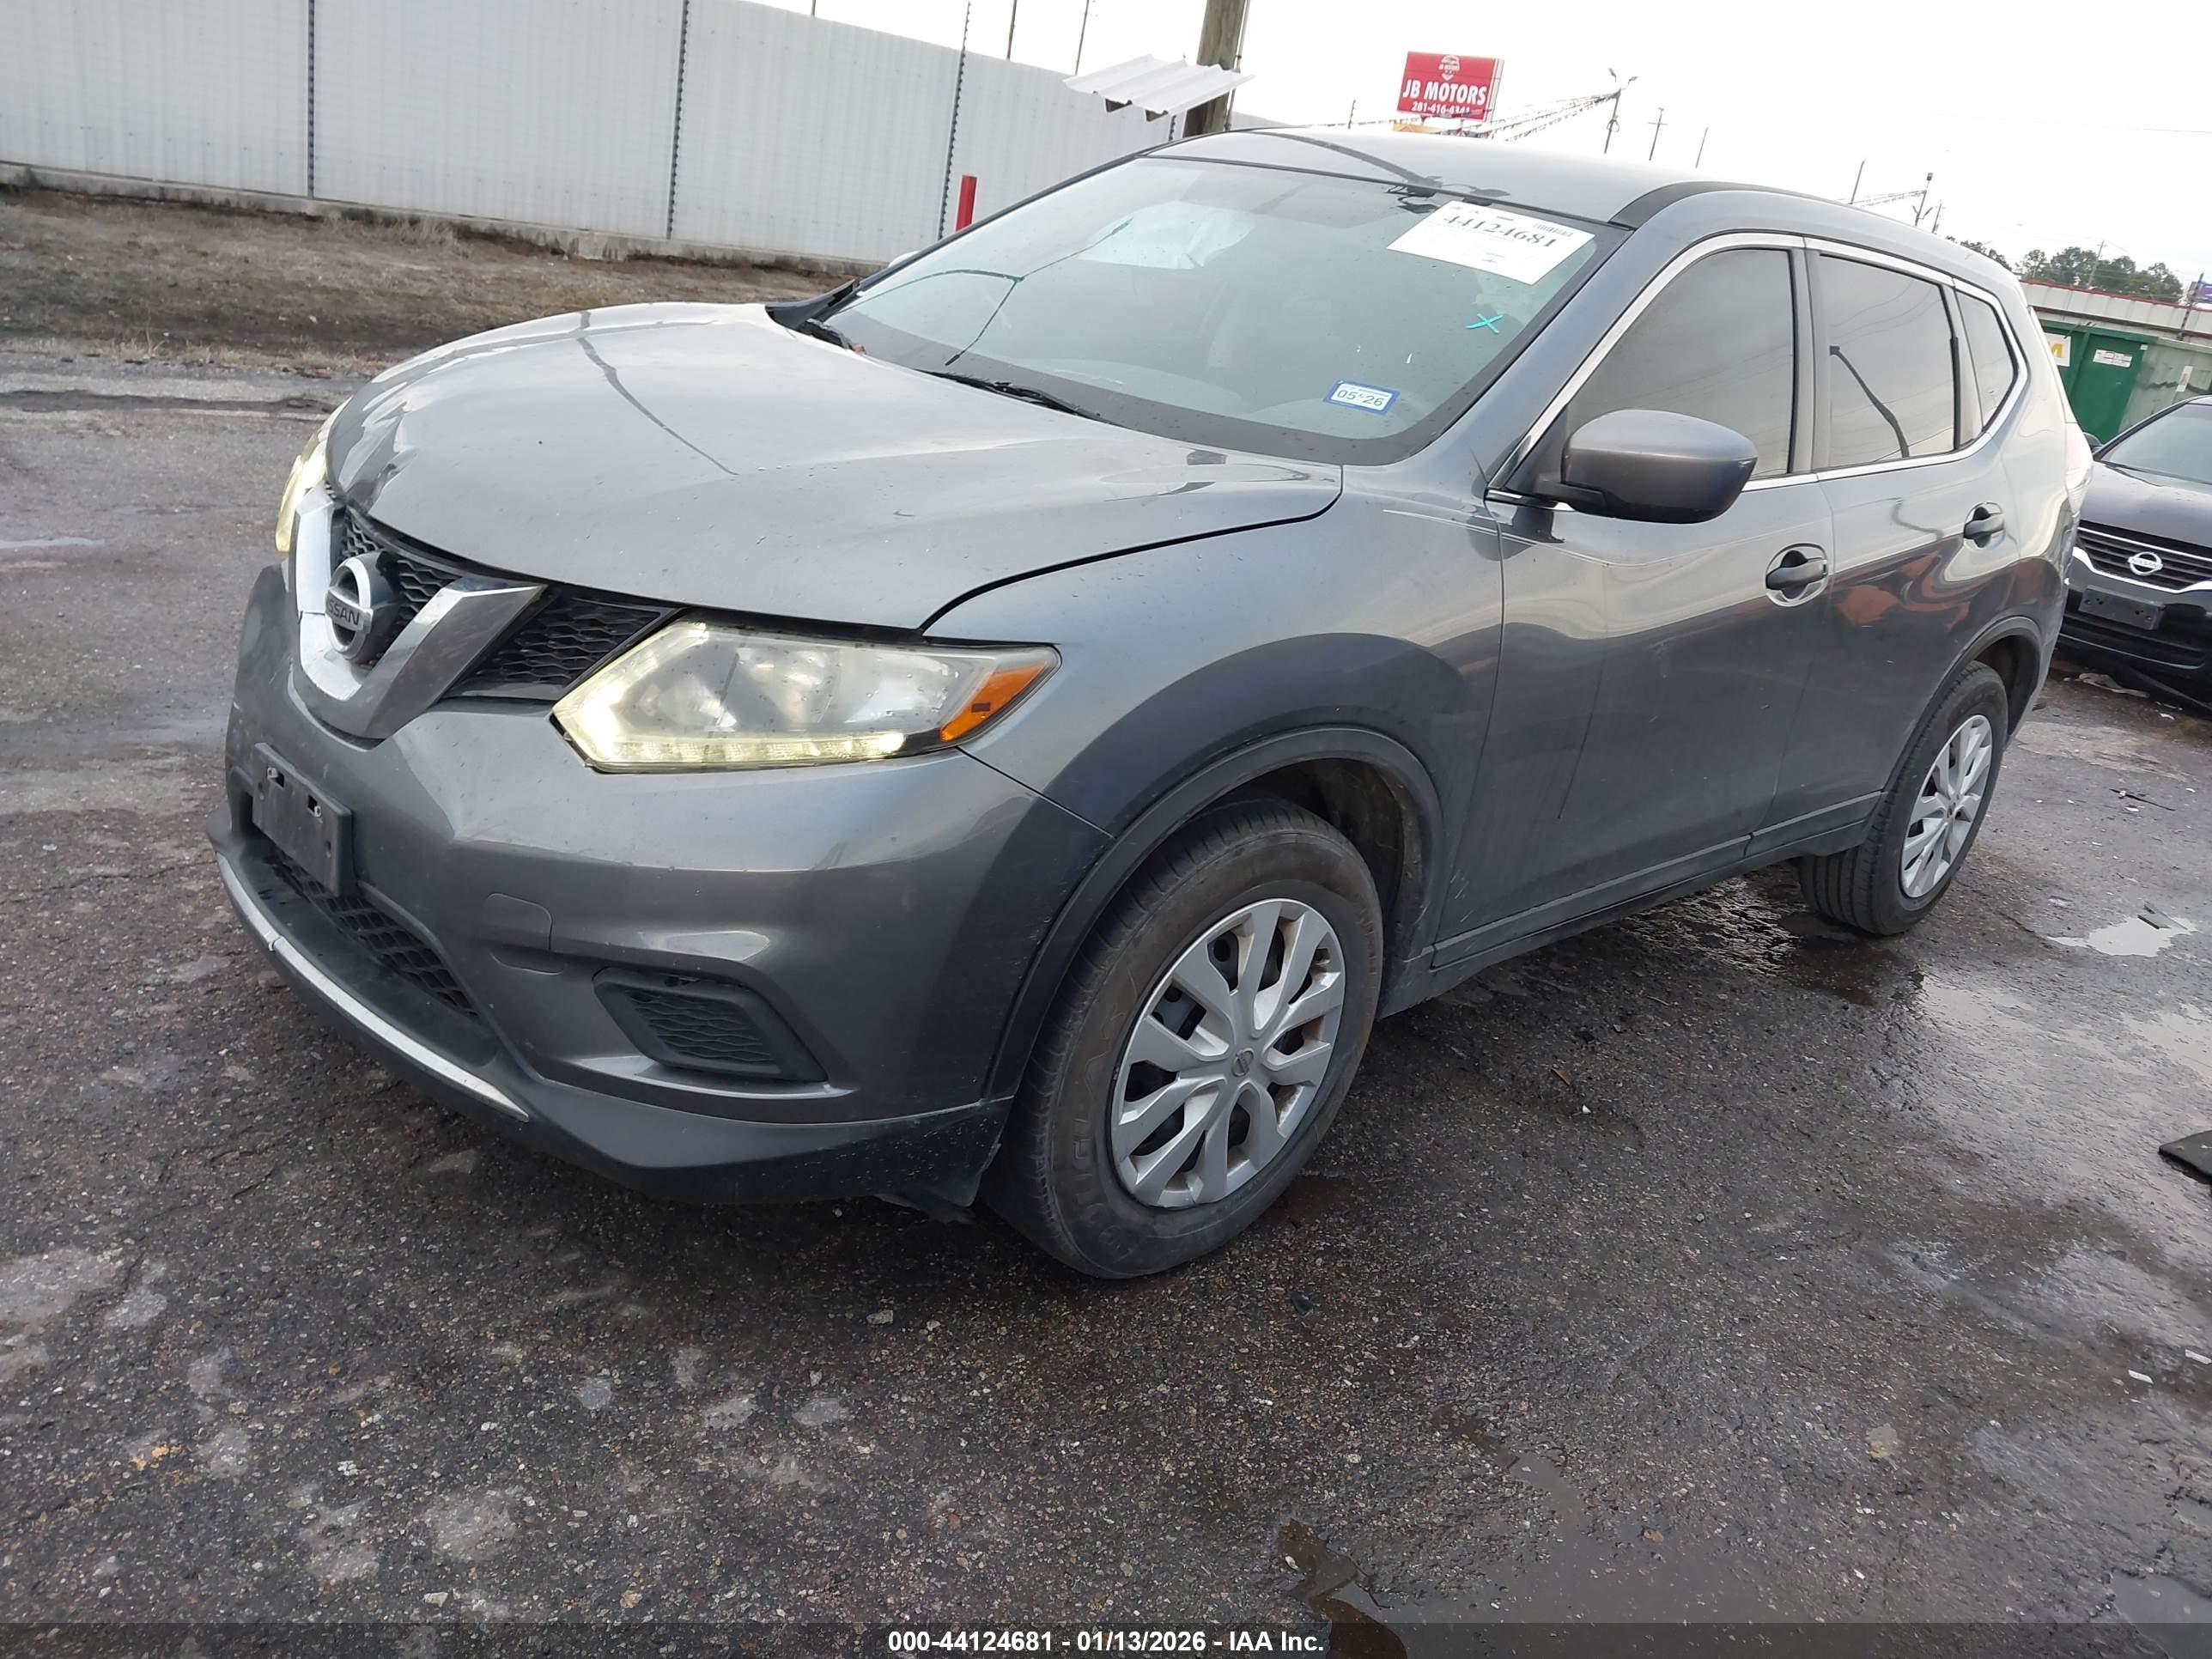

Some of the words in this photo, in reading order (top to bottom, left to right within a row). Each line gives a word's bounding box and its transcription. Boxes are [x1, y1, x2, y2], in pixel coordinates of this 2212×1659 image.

[1402, 79, 1421, 99] JB
[1424, 81, 1487, 106] MOTORS
[1443, 215, 1558, 247] 44124681
[1336, 389, 1358, 400] 05
[1362, 395, 1384, 406] 26
[328, 599, 361, 626] SSAN
